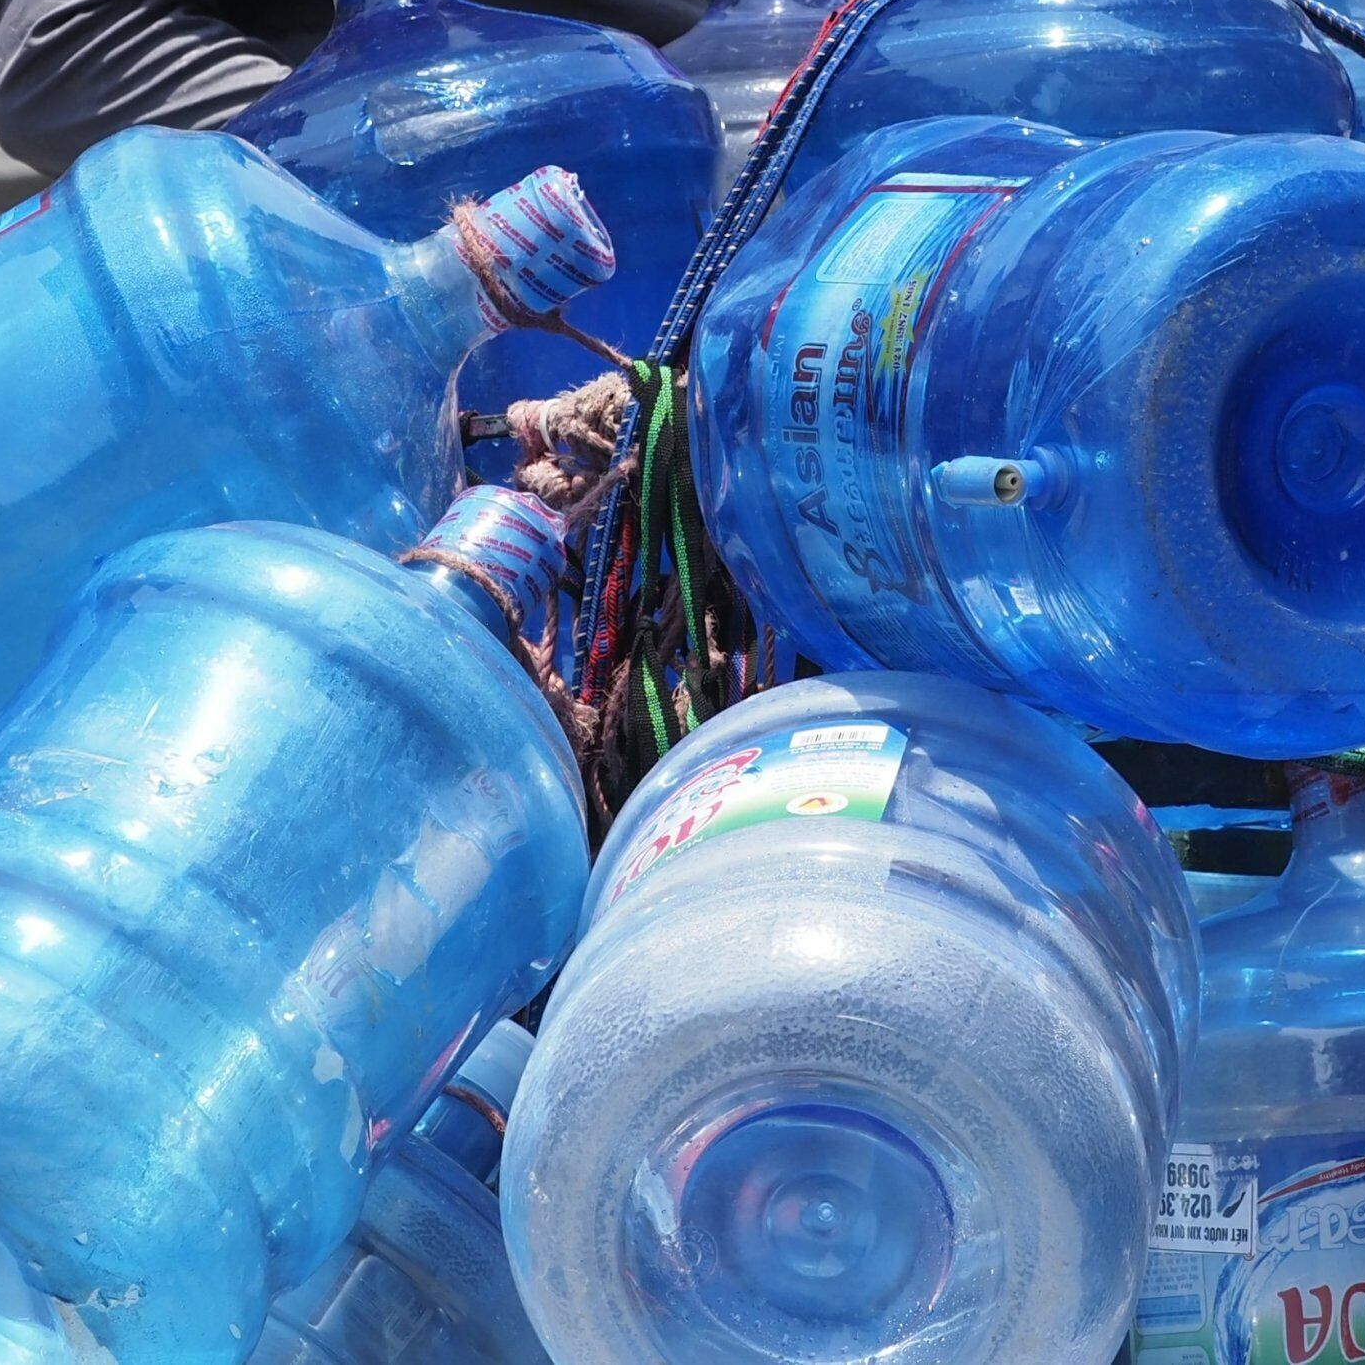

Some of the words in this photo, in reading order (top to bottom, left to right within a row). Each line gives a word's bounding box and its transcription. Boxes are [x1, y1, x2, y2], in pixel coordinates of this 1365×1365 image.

[782, 342, 840, 538] Asian
[1187, 1226, 1202, 1240] XIN
[1231, 1228, 1248, 1247] HẾT
